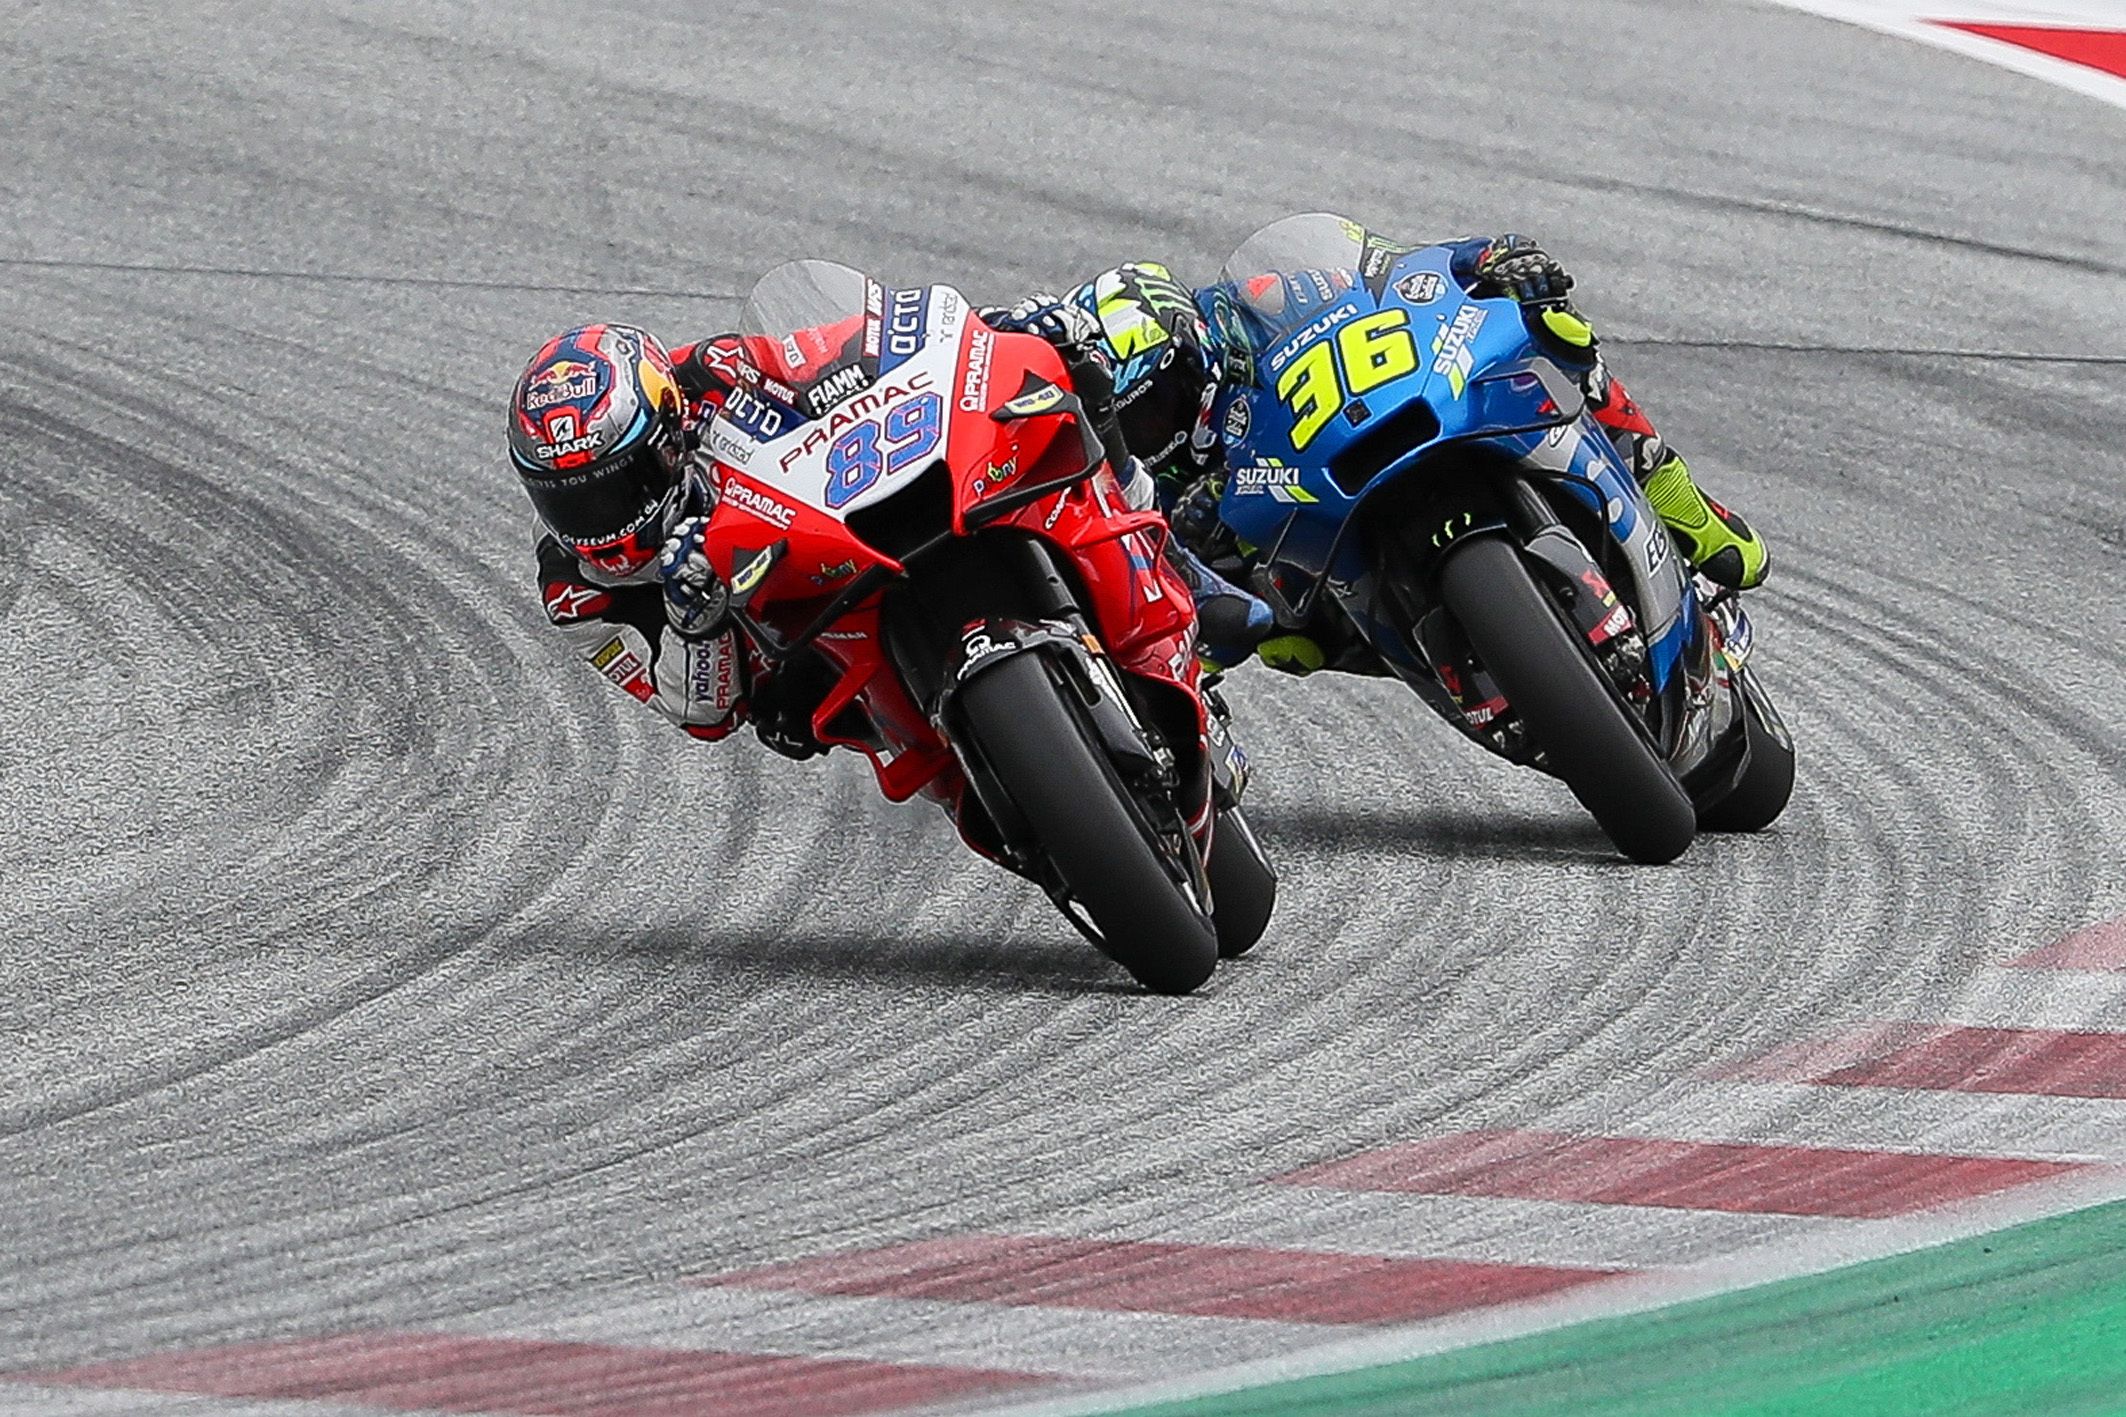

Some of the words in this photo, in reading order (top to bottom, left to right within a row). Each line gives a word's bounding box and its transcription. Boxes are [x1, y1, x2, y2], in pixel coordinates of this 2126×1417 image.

[965, 330, 988, 397] PRAMAC
[1271, 304, 1358, 370] SUZUKI
[1433, 305, 1480, 375] SUZUKI
[562, 377, 597, 401] Bull
[808, 365, 866, 408] FIAMM
[1277, 308, 1418, 451] 36
[536, 432, 602, 459] SHARK
[779, 370, 935, 474] PRAMAC
[823, 391, 943, 509] 89
[731, 484, 797, 526] PRAMAC
[1236, 468, 1299, 485] SUZUKI
[608, 656, 639, 682] OTUL
[714, 631, 734, 710] PRAMAC
